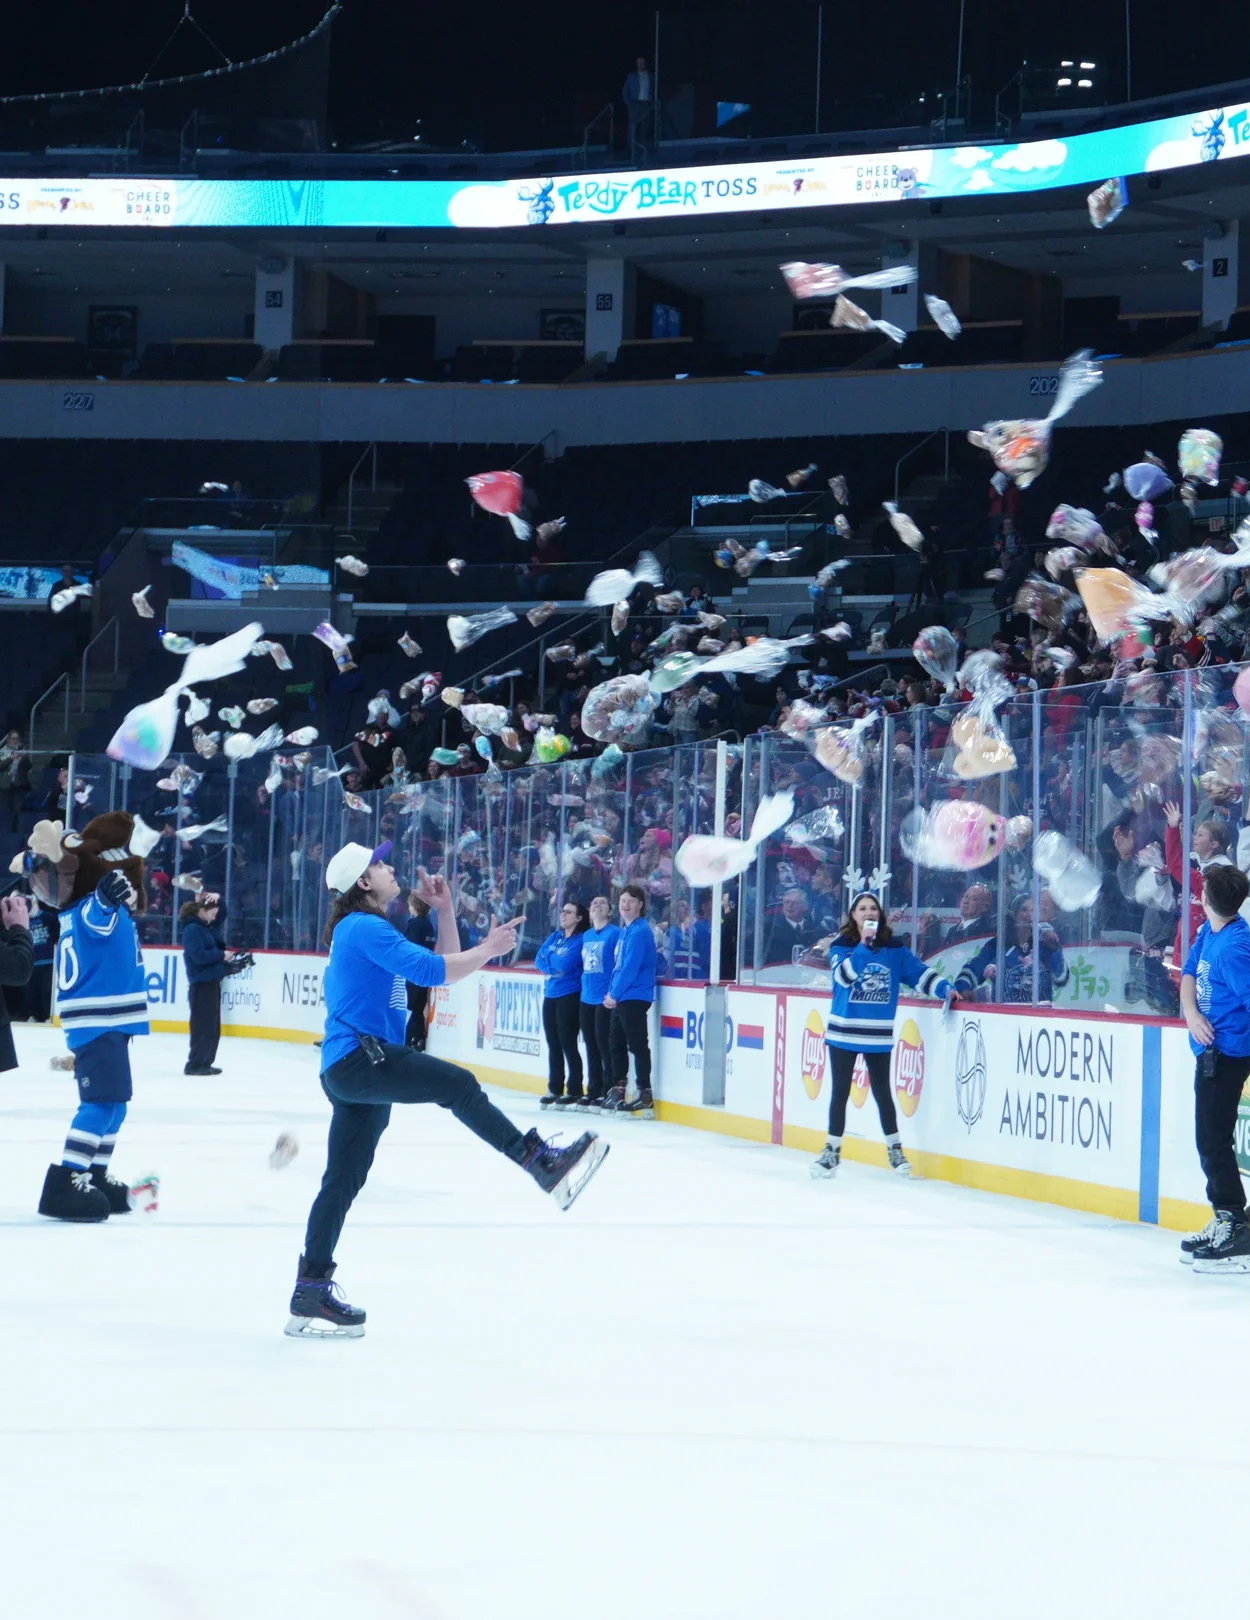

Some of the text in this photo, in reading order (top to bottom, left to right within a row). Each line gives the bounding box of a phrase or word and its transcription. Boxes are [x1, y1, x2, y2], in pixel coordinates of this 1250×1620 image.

[856, 165, 898, 178] CHEER
[702, 177, 757, 198] TOSS
[856, 177, 899, 191] BOARD
[127, 191, 170, 202] CHEER
[126, 204, 170, 214] BOARD
[1216, 260, 1224, 275] 2
[1030, 377, 1058, 394] 202
[64, 393, 94, 411] 227
[144, 955, 177, 1004] ell
[776, 1004, 784, 1112] CCM
[802, 1029, 825, 1081] Lay's
[1016, 1026, 1113, 1086] MODERN
[896, 1040, 924, 1097] Lay's
[999, 1088, 1112, 1152] AMBITION
